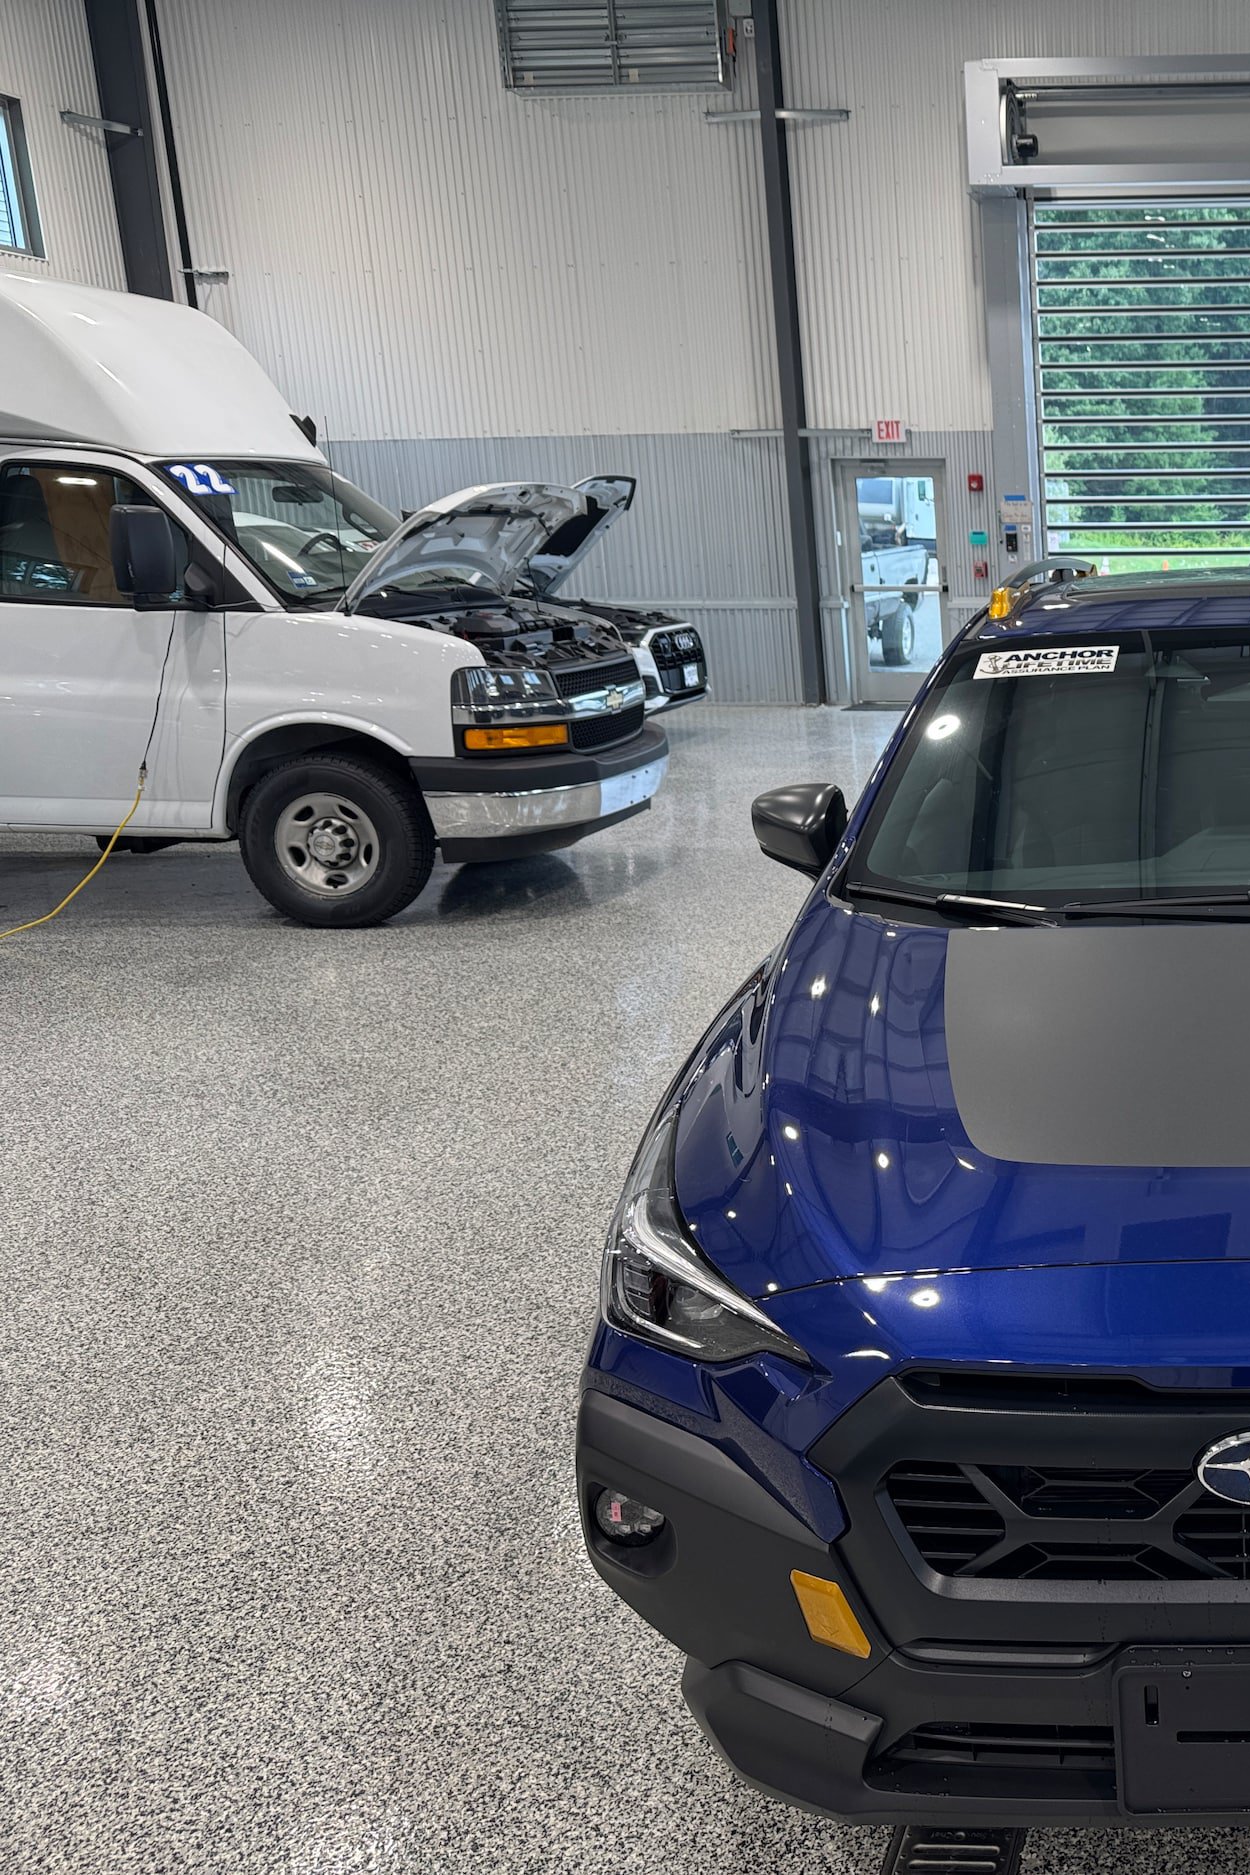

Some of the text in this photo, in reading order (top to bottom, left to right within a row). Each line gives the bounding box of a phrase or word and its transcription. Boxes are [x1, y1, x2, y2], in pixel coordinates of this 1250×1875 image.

[877, 420, 901, 440] EXIT
[168, 464, 236, 494] 22
[1003, 649, 1114, 663] ANCHOR
[1001, 658, 1112, 670] LIFETIME
[1002, 665, 1076, 675] ASSURANCE
